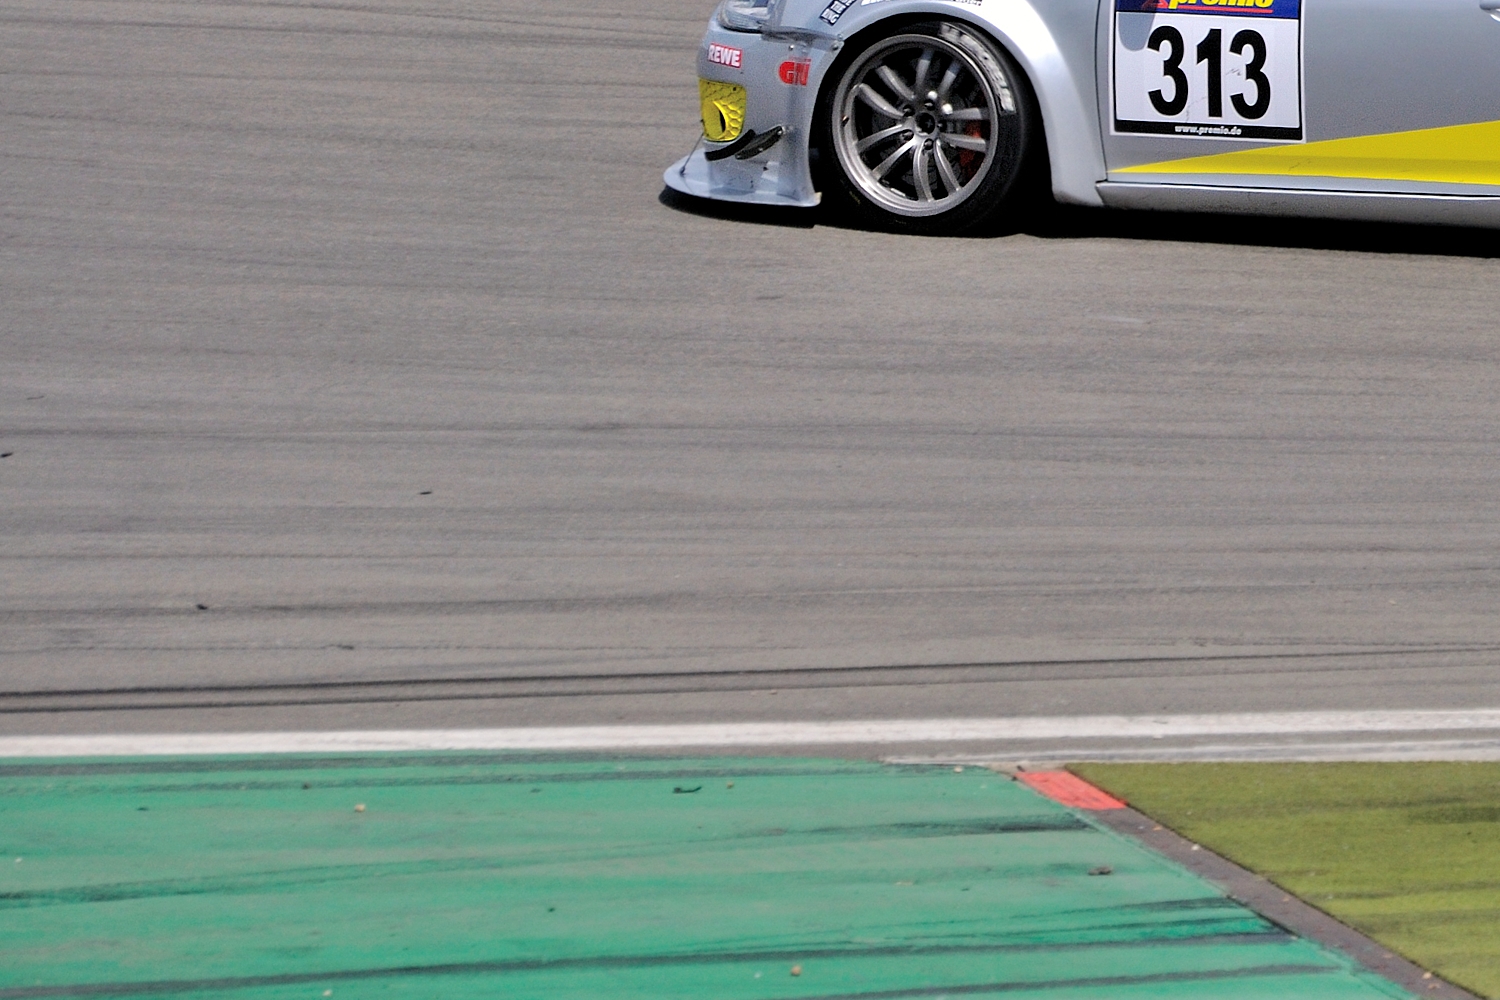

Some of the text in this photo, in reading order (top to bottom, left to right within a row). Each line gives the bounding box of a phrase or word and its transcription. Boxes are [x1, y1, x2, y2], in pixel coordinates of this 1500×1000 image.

[707, 44, 741, 68] REWE
[1147, 25, 1271, 120] 313
[1174, 125, 1242, 136] www.premio.de
